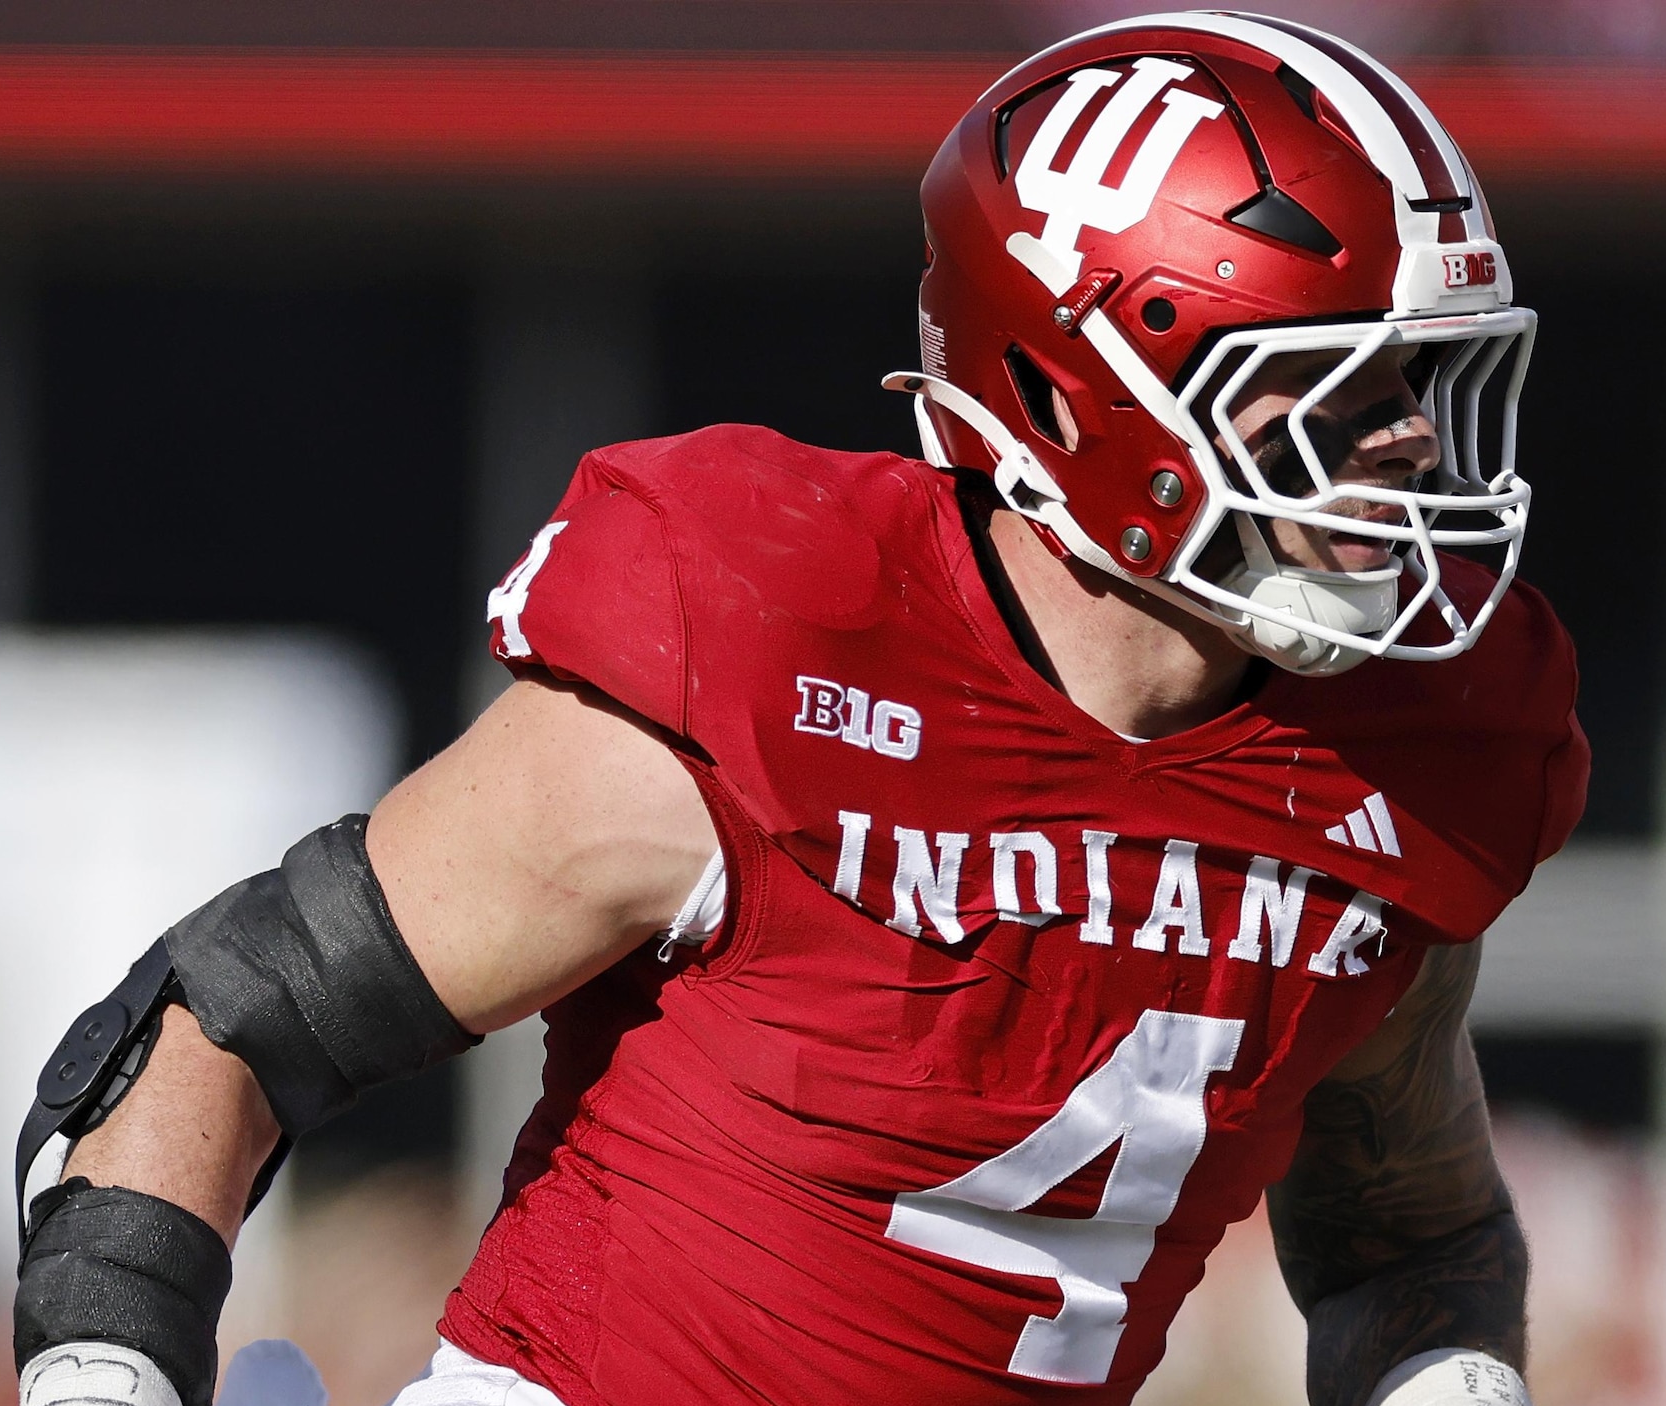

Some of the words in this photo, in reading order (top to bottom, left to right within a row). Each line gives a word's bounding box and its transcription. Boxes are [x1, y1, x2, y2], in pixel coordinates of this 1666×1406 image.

[487, 521, 569, 657] 4
[833, 810, 1392, 976] INDIANA
[884, 1008, 1246, 1384] 4
